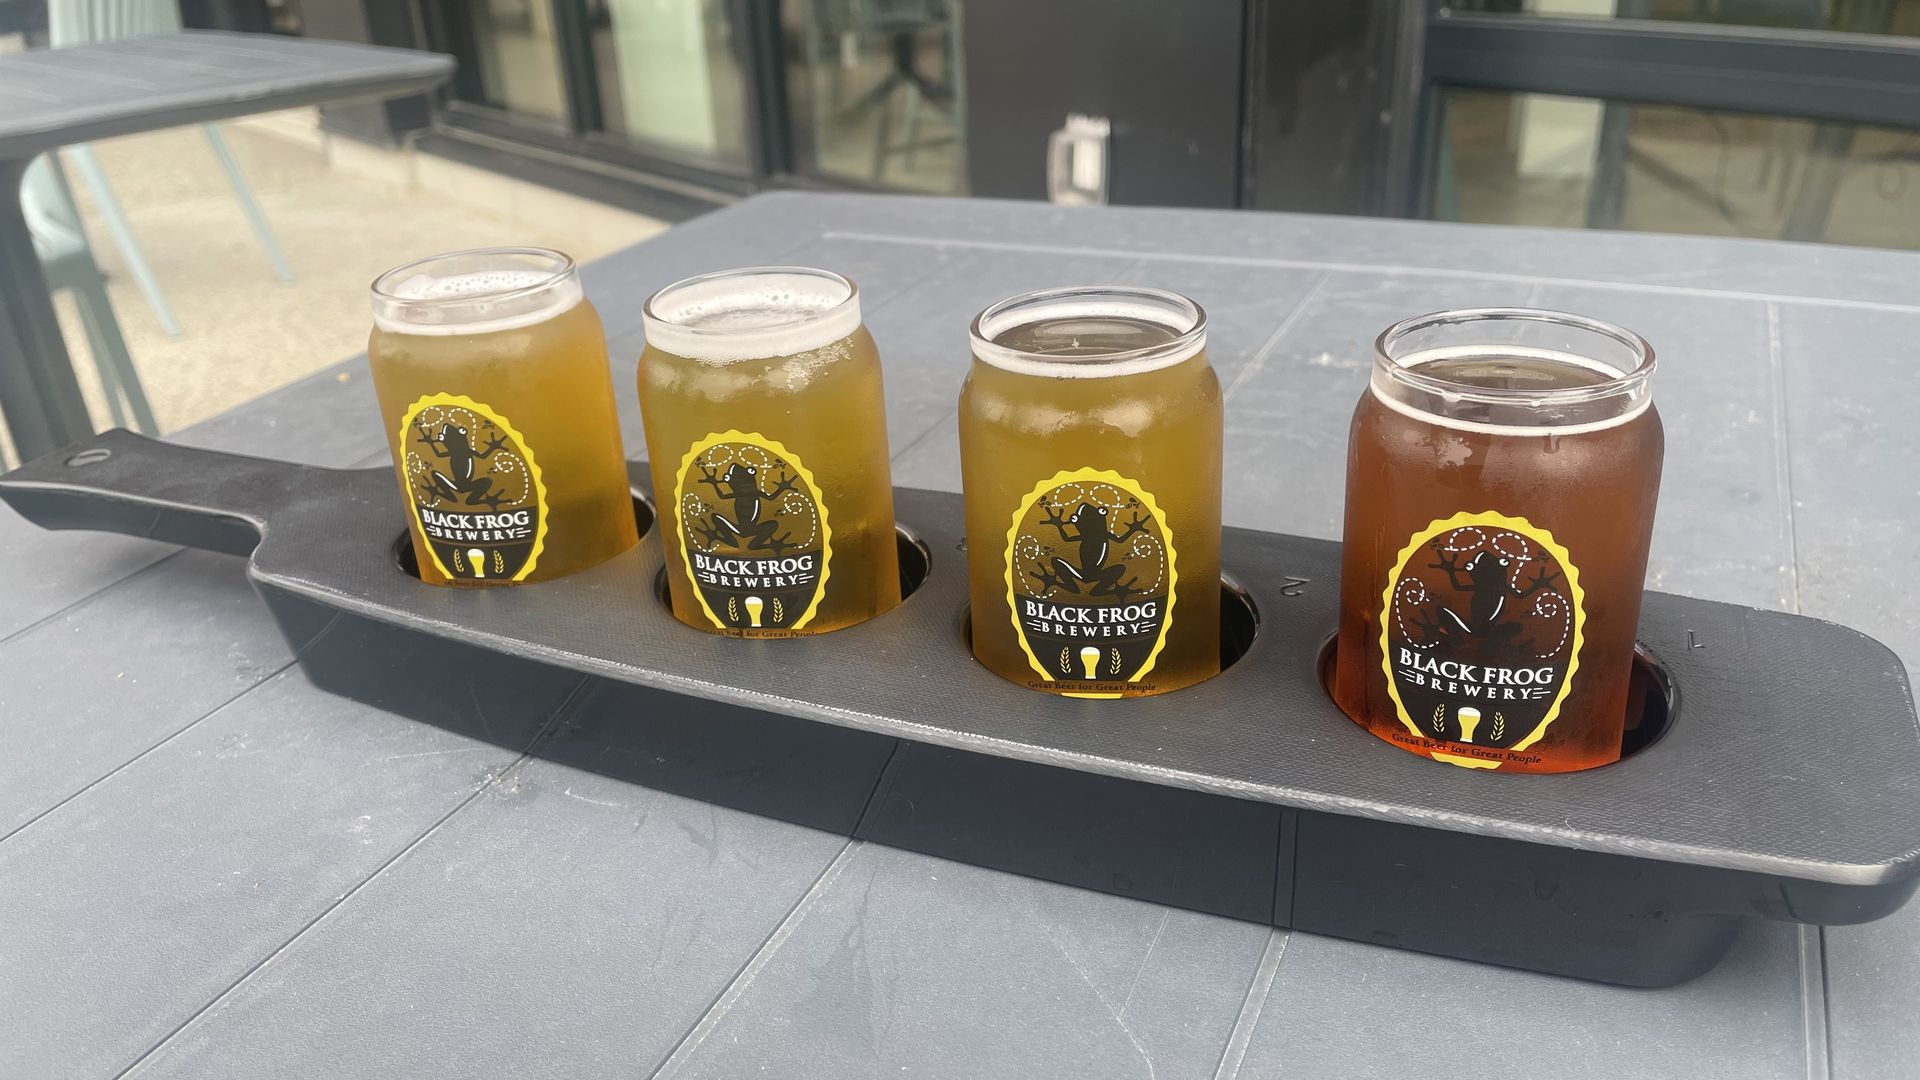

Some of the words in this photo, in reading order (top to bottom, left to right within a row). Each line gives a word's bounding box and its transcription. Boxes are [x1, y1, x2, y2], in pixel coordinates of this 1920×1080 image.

[421, 509, 473, 529] BLACK
[474, 510, 530, 529] FROG
[435, 527, 516, 541] BREWERY
[694, 553, 754, 576] BLACK
[755, 555, 814, 576] FROG
[709, 574, 800, 589] BREWERY
[1025, 600, 1094, 624] BLACK
[1097, 602, 1157, 624] FROG
[1041, 622, 1141, 638] BREWERY
[1400, 647, 1478, 683] BLACK
[1482, 667, 1554, 685] FROG
[1027, 680, 1052, 689] Great
[1054, 682, 1075, 690] Beer
[1077, 683, 1093, 691] for
[1096, 683, 1125, 691] Great
[1126, 683, 1156, 693] People
[1415, 672, 1533, 701] BREWERY
[1392, 733, 1420, 746] Great
[1423, 740, 1448, 751] Beer
[1450, 744, 1468, 754] for
[1471, 748, 1504, 760] Great
[1506, 751, 1542, 765] People
